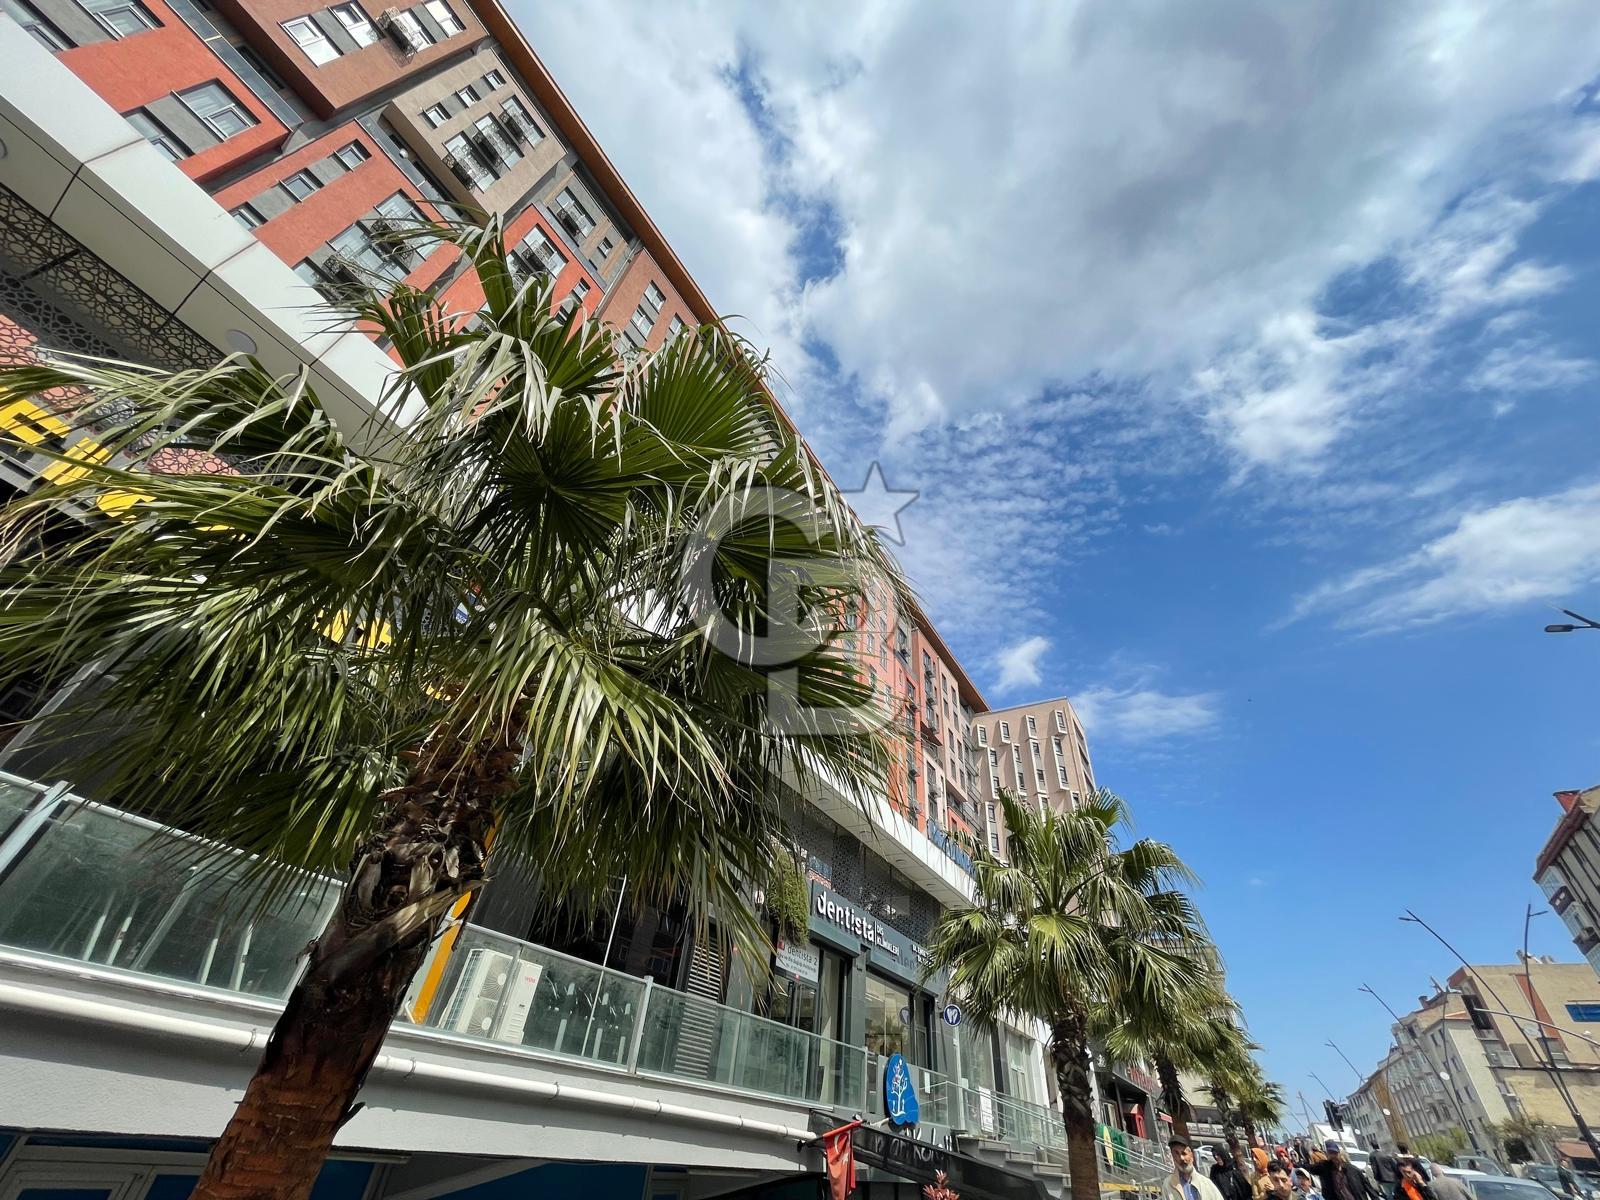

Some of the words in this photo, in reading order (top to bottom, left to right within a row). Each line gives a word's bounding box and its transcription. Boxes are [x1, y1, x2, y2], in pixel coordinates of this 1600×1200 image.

[817, 891, 875, 942] dentista
[787, 945, 813, 964] dentista
[813, 957, 818, 967] 2
